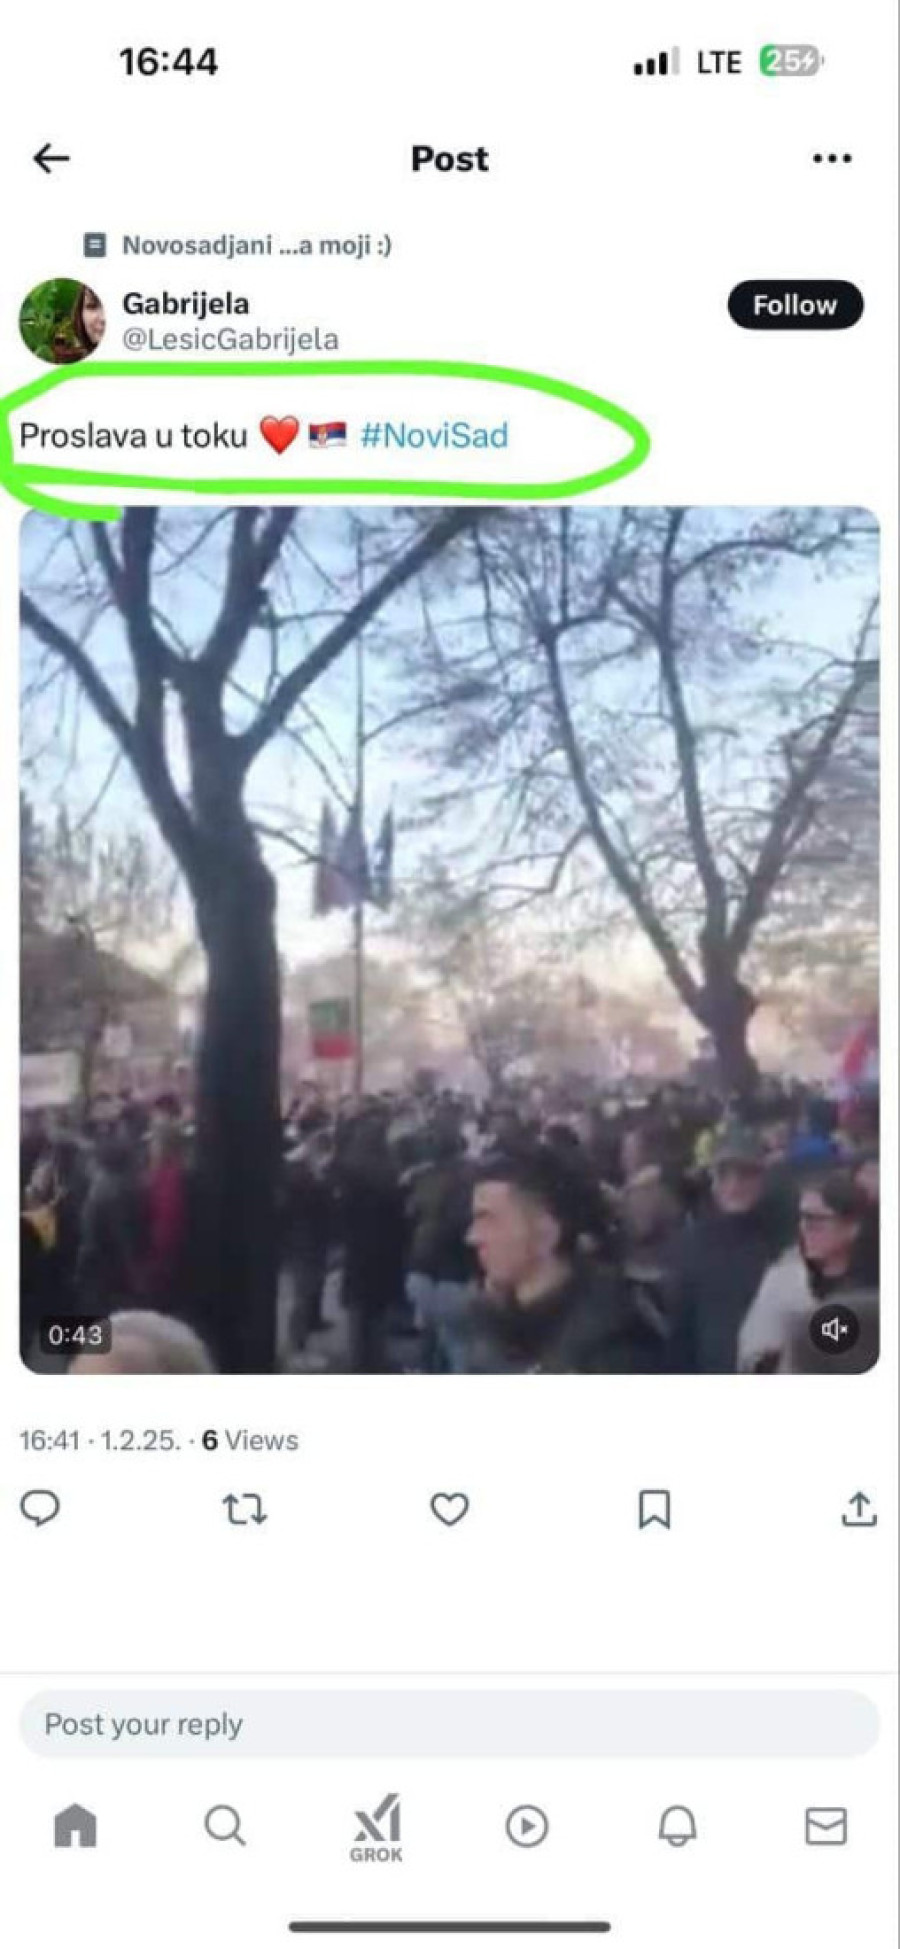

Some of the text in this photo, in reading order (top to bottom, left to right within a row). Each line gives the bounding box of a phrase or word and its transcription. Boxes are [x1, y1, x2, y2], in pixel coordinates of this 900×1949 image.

[120, 47, 218, 76] 16:44
[698, 51, 741, 74] LTE
[766, 49, 800, 71] 25
[413, 145, 489, 172] Post
[124, 235, 271, 259] Novosadjani
[321, 235, 370, 259] moji
[123, 291, 248, 320] Gabrijela
[755, 293, 837, 315] Follow
[124, 328, 338, 355] @LesicGabrijela
[21, 422, 507, 448] Proslava u toku #NoviSad
[50, 1325, 101, 1345] 0:43
[21, 1430, 298, 1451] 16:41 1.2.25. 6 Views
[46, 1713, 242, 1740] Post your reply
[351, 1848, 402, 1861] GROK
